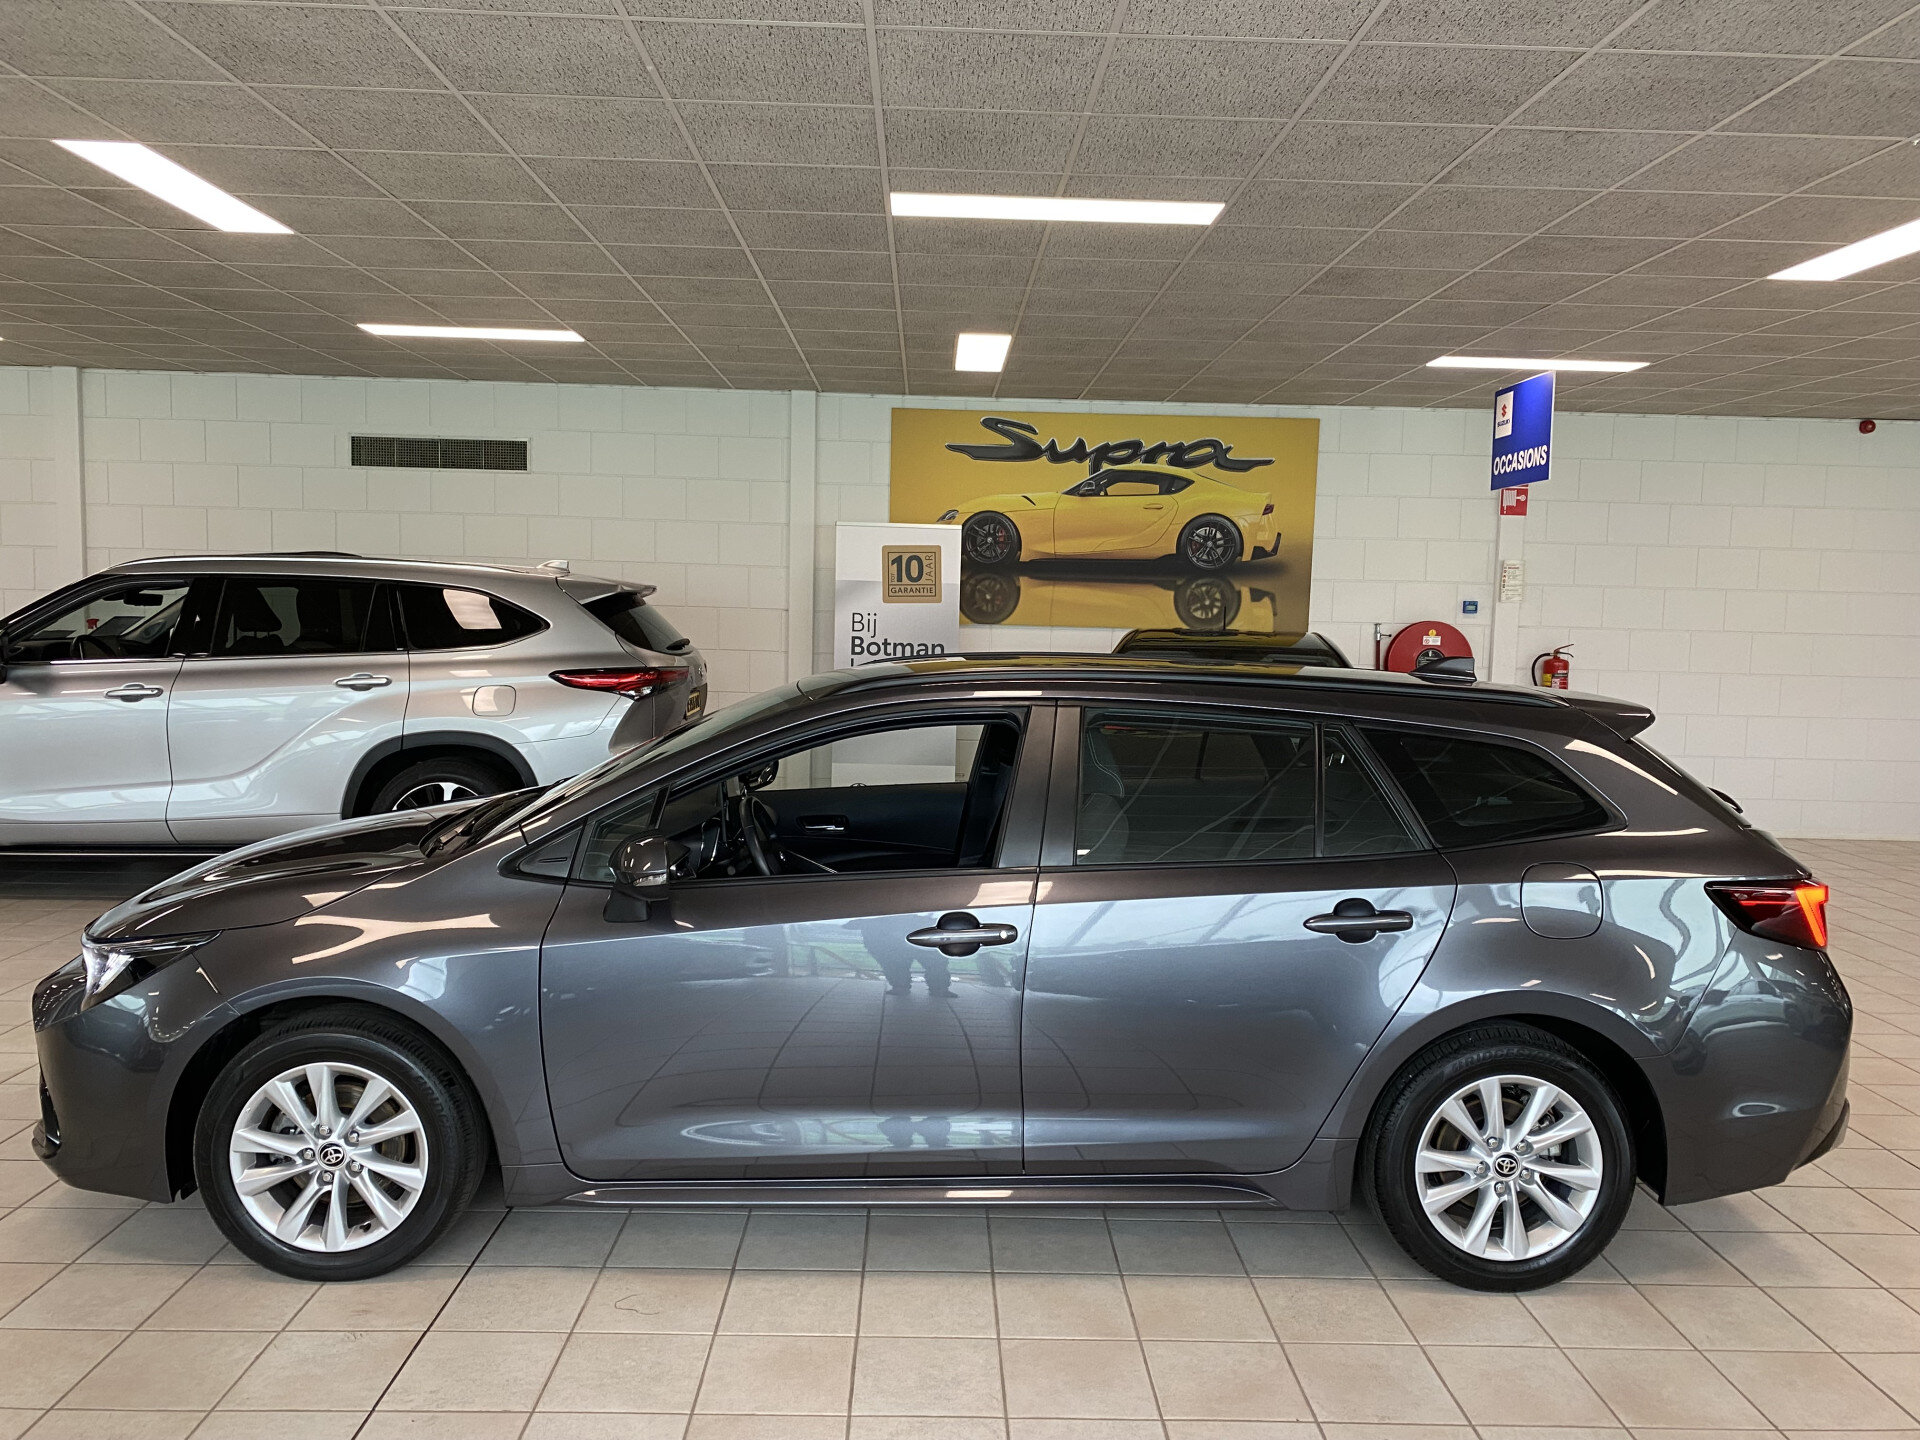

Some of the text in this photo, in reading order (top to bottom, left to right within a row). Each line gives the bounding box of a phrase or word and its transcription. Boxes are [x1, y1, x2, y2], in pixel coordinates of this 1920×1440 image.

[945, 416, 1275, 476] Supra
[1493, 445, 1548, 476] OCCASIONS
[891, 554, 924, 583] 10
[925, 554, 934, 583] JAAR
[851, 612, 878, 638] Bij
[850, 635, 945, 657] Botman
